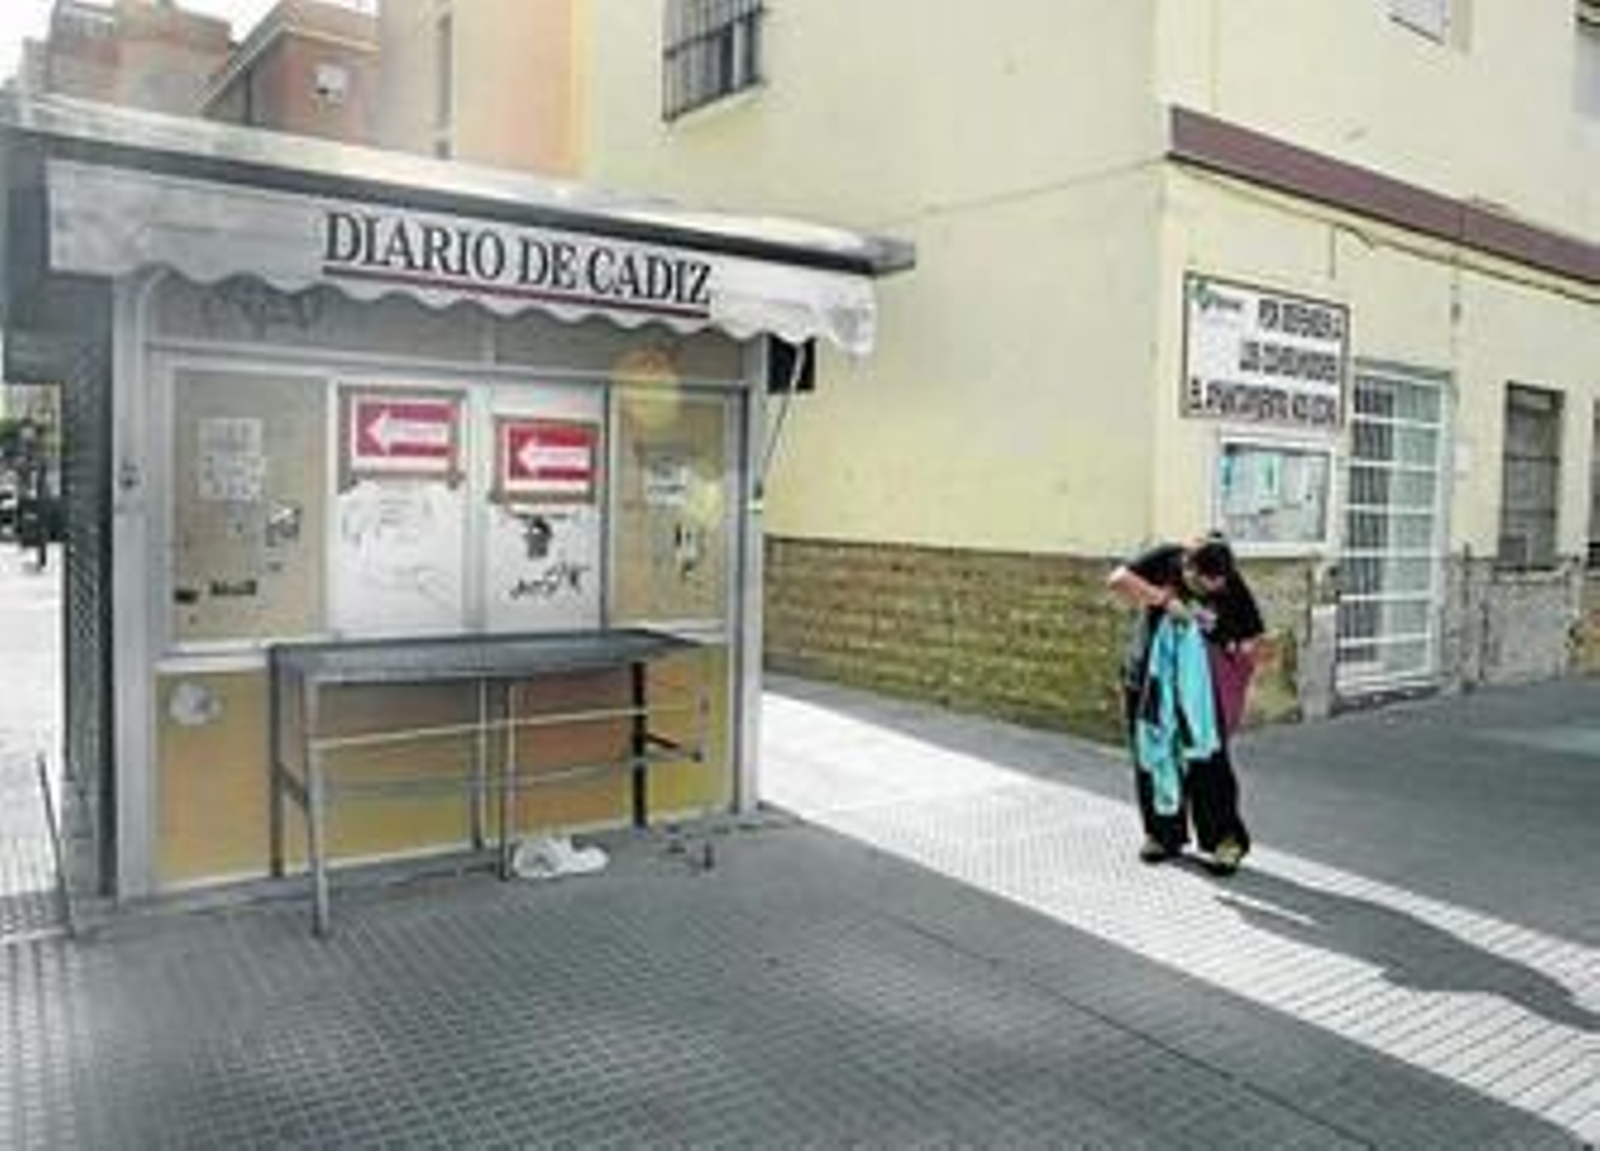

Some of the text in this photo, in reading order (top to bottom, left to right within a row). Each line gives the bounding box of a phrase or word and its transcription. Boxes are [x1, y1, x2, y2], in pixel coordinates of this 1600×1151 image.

[325, 212, 712, 305] DIARIO DE CADIZ
